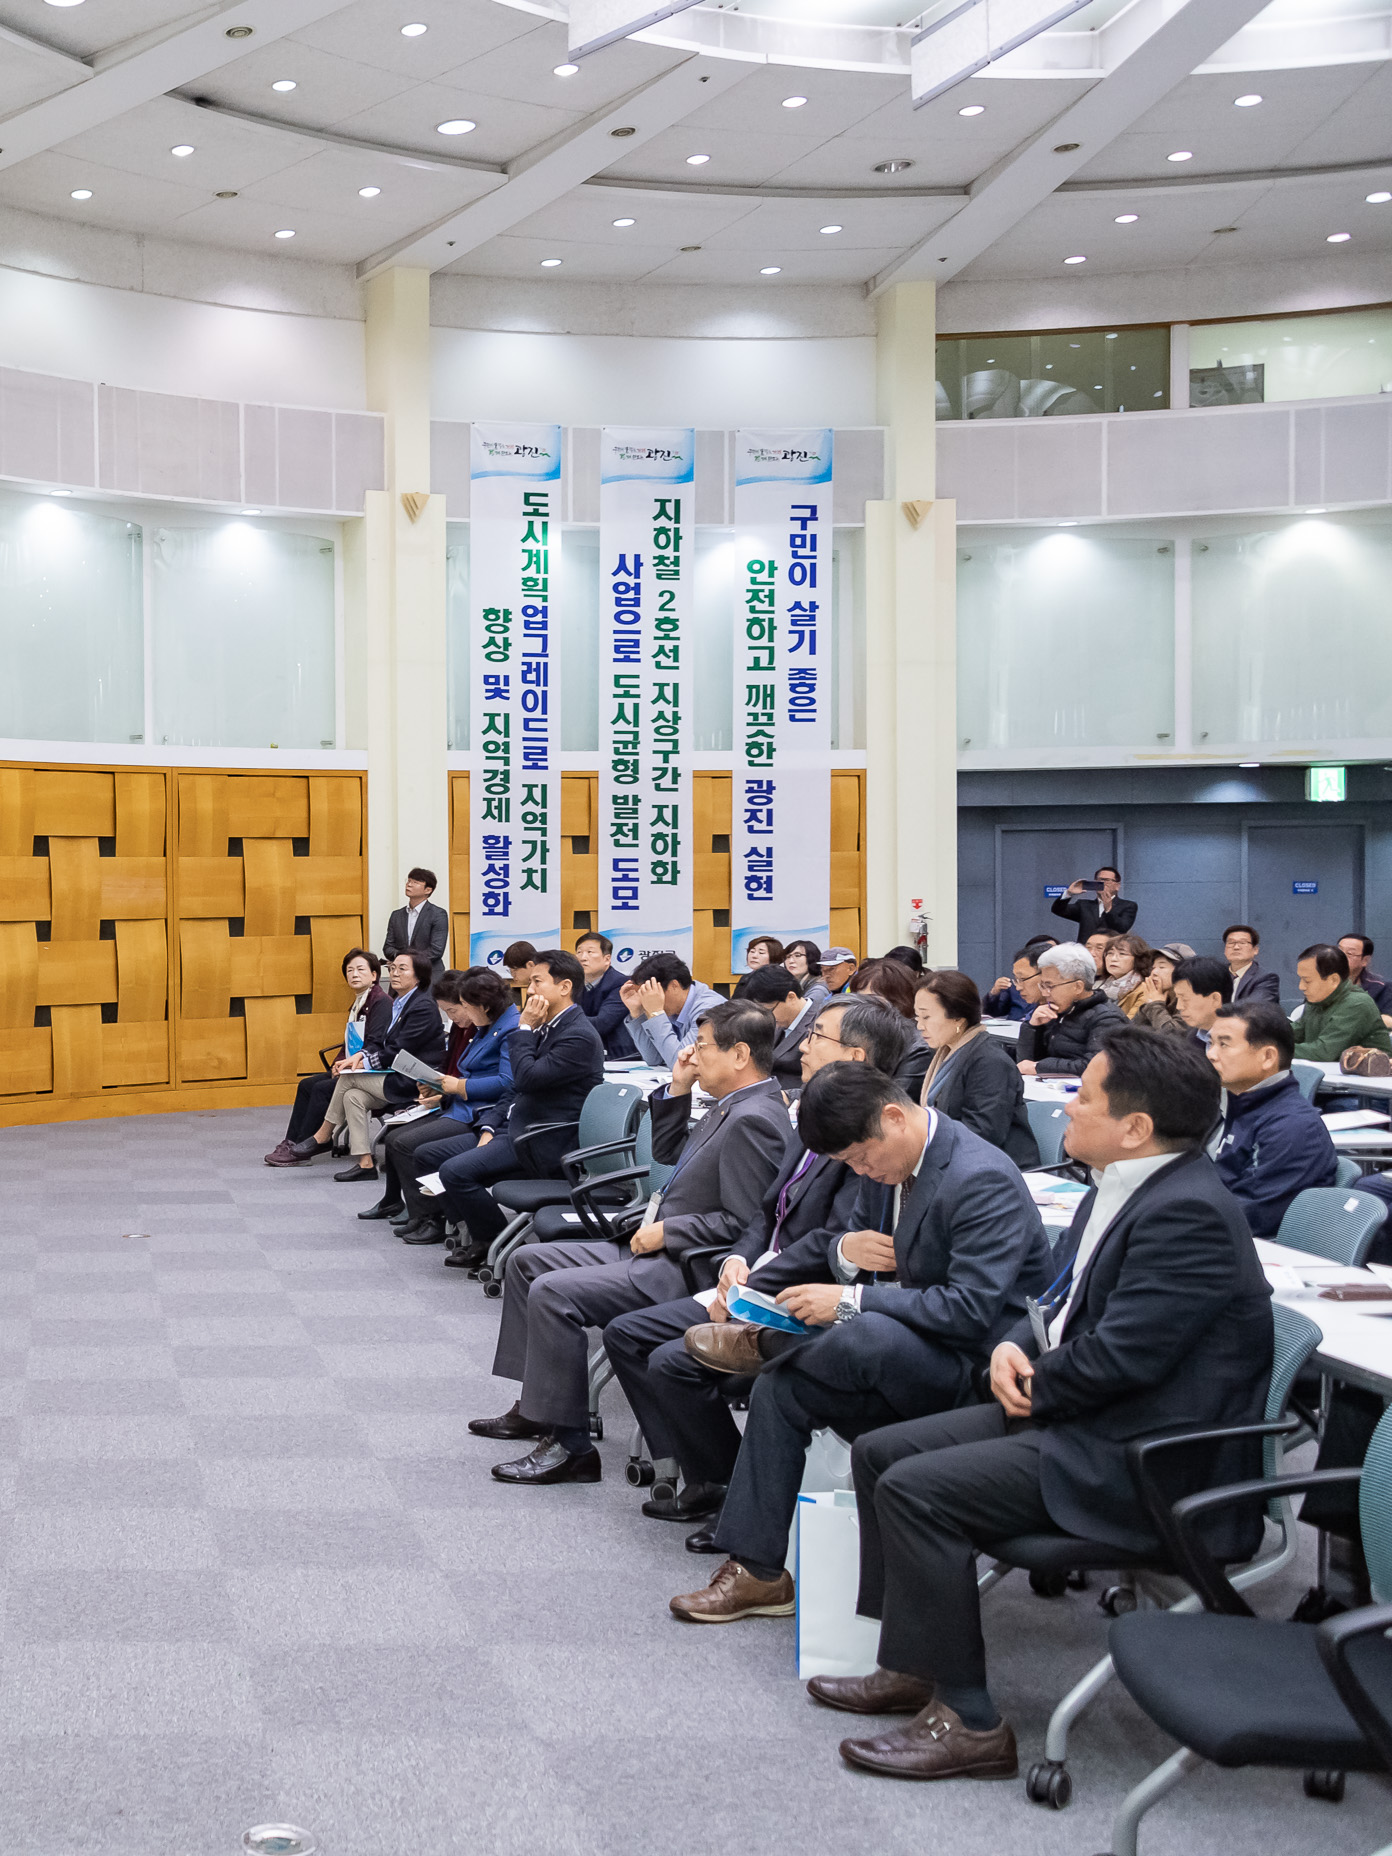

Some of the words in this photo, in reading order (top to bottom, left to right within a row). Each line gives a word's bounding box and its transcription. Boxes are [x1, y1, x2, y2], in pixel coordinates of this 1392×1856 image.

[514, 444, 540, 458] 광진
[646, 448, 672, 461] 광진
[782, 449, 809, 462] 광진
[787, 504, 819, 589] 구민이
[482, 607, 512, 663] 향상
[521, 492, 549, 771] 도시계획업그레이드로
[611, 553, 643, 664] 사업으로
[745, 559, 778, 672] 안전하고
[786, 600, 820, 656] 살기
[482, 674, 511, 701] 및
[787, 667, 818, 723] 좋은
[610, 674, 642, 785] 도시균형
[650, 682, 681, 792] 지상구간
[745, 684, 777, 767] 깨끗한
[481, 712, 510, 823] 지역경제
[520, 783, 549, 893] 지역가치
[610, 794, 642, 848] 발전
[744, 779, 776, 835] 광진
[481, 834, 512, 918] 활성화
[650, 804, 681, 886] 지하화
[743, 846, 774, 901] 실현
[610, 857, 640, 911] 도모
